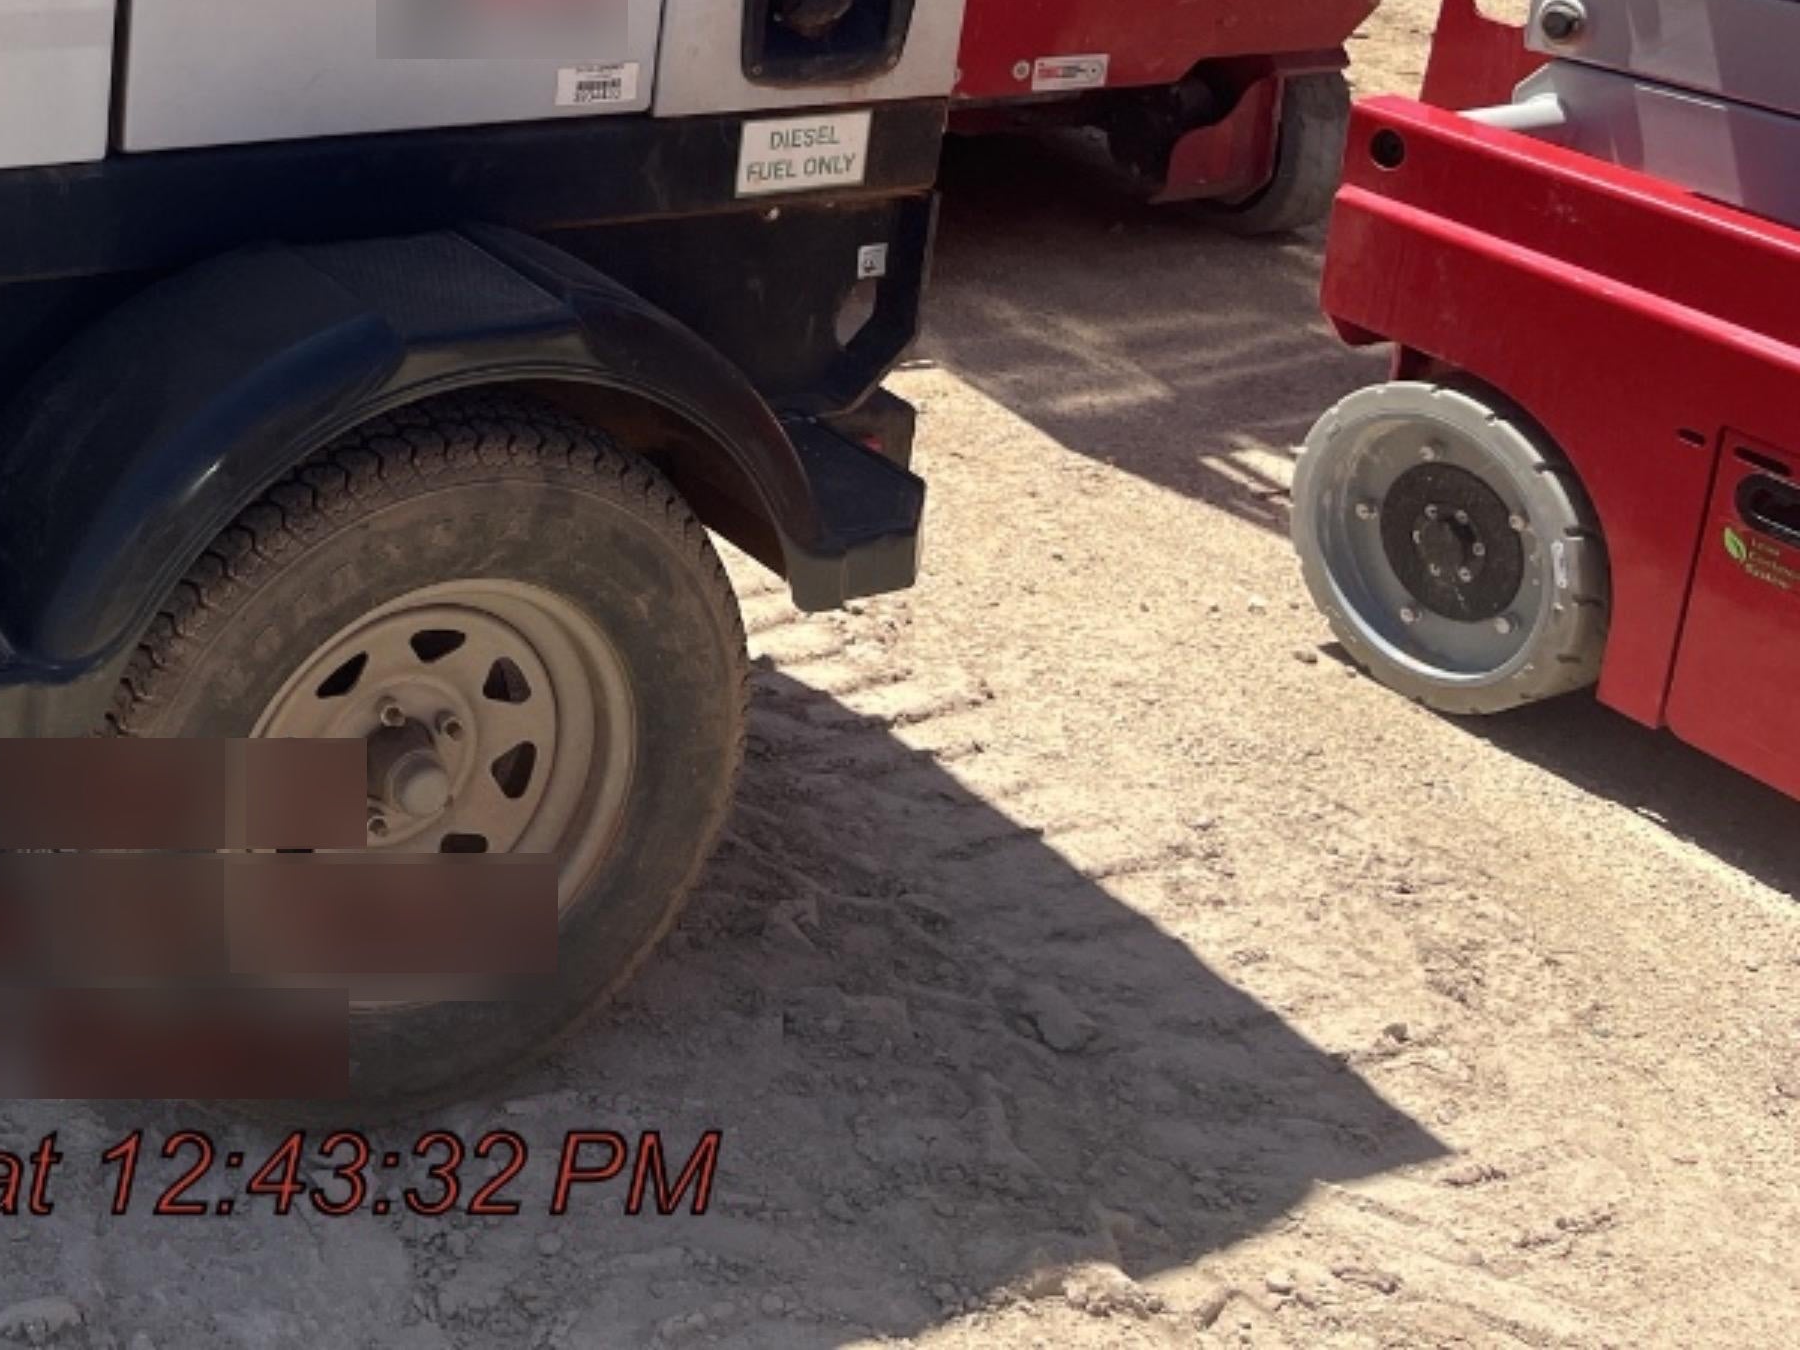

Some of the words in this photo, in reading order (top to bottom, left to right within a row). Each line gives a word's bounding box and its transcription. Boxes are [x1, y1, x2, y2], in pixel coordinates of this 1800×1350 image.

[769, 125, 841, 151] DIESEL
[746, 159, 797, 182] FUEL
[803, 153, 857, 177] ONLY
